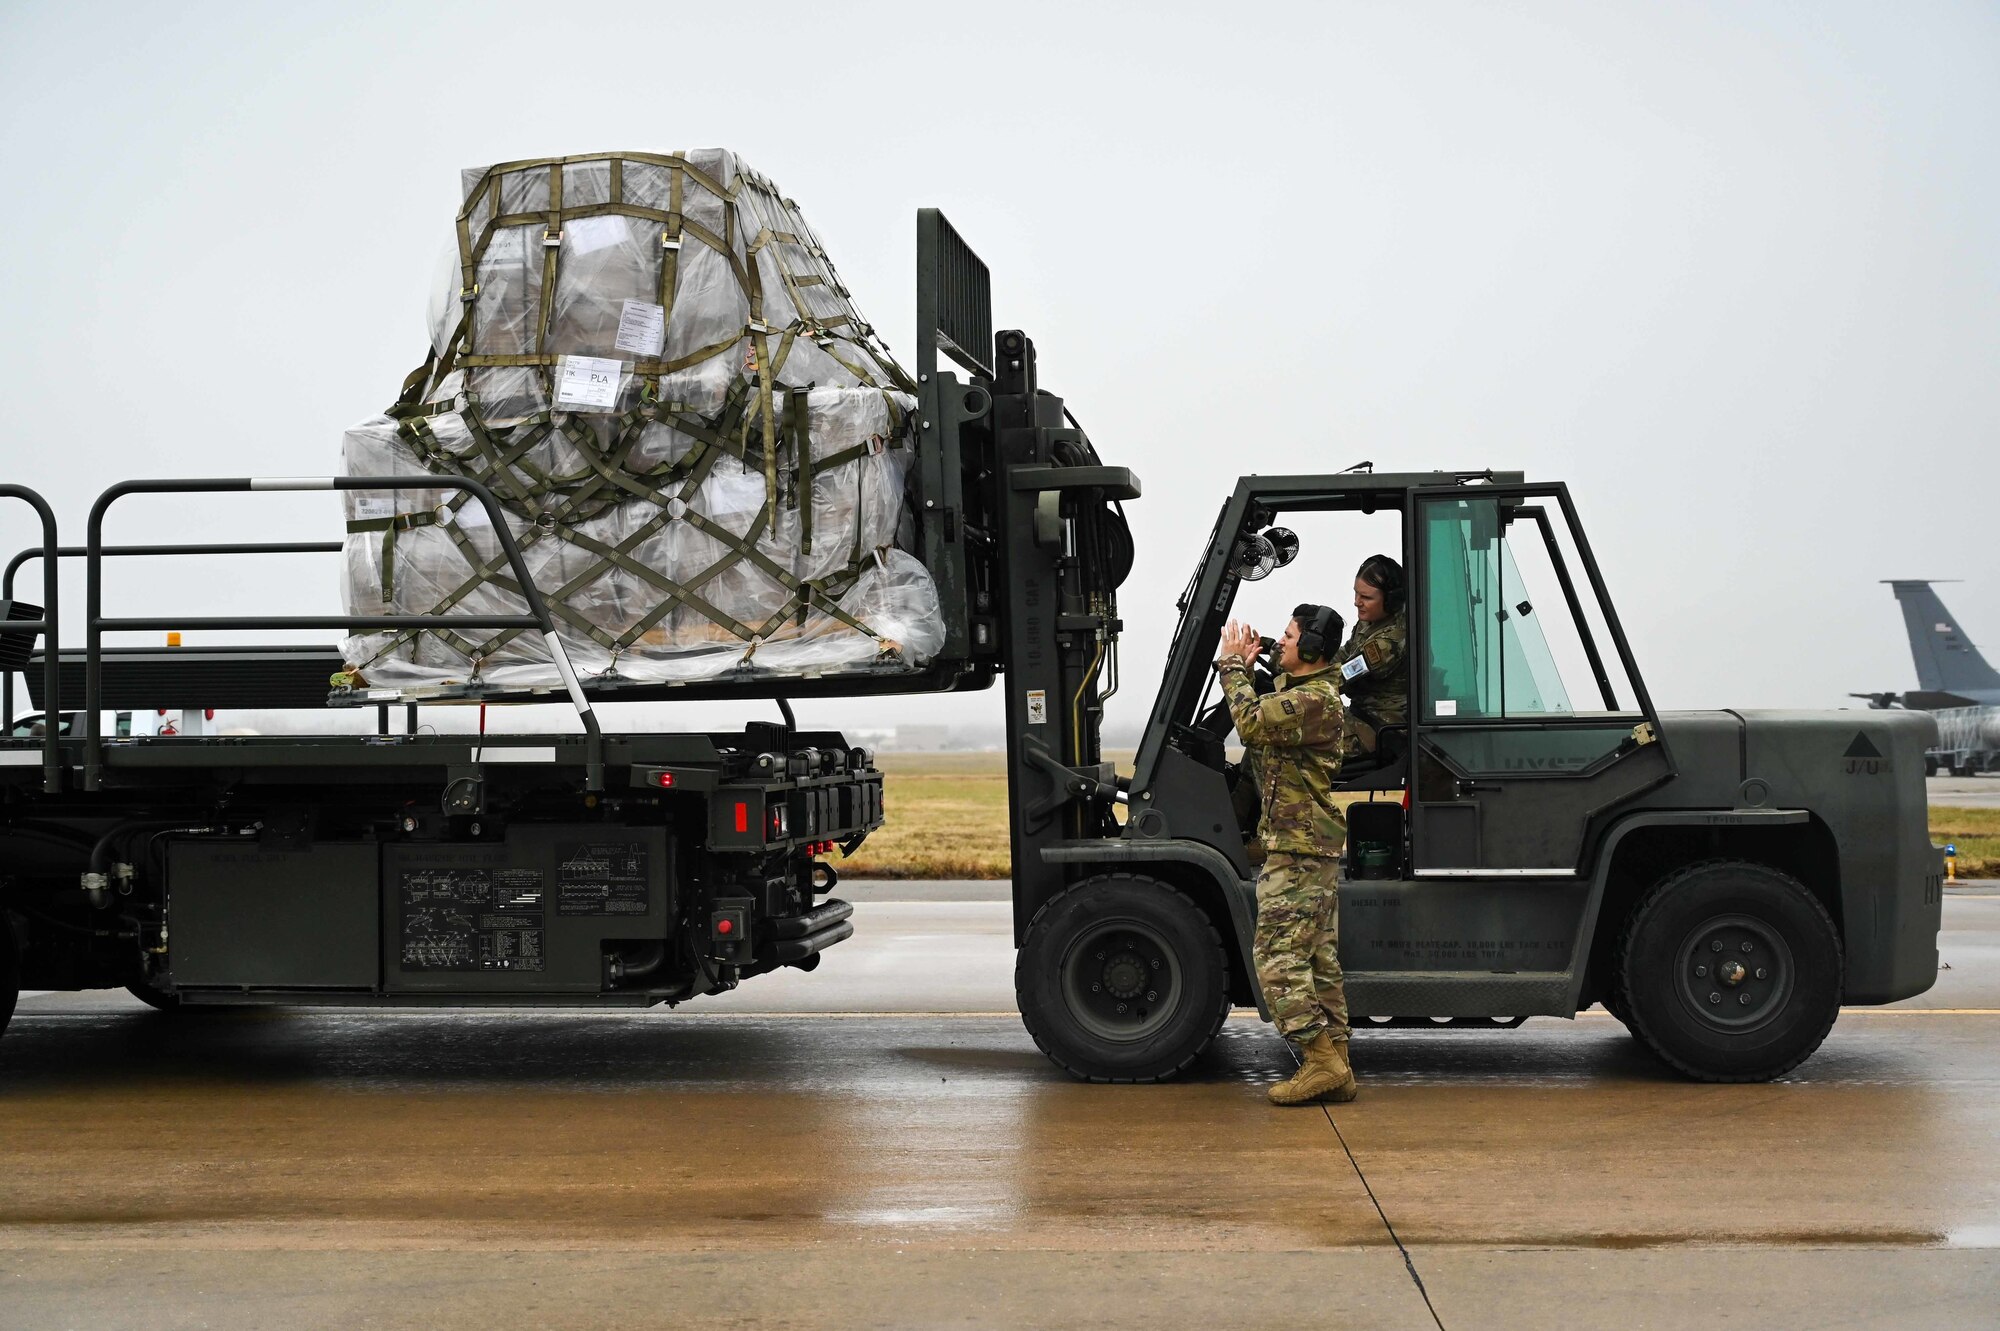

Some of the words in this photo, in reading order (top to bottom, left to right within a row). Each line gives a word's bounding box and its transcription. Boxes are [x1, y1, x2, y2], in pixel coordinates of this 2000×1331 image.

[591, 373, 609, 384] PLA
[1025, 579, 1039, 607] CAP
[1845, 759, 1879, 775] J/U
[1351, 898, 1378, 907] DIESEL
[1383, 898, 1401, 907] FUEL
